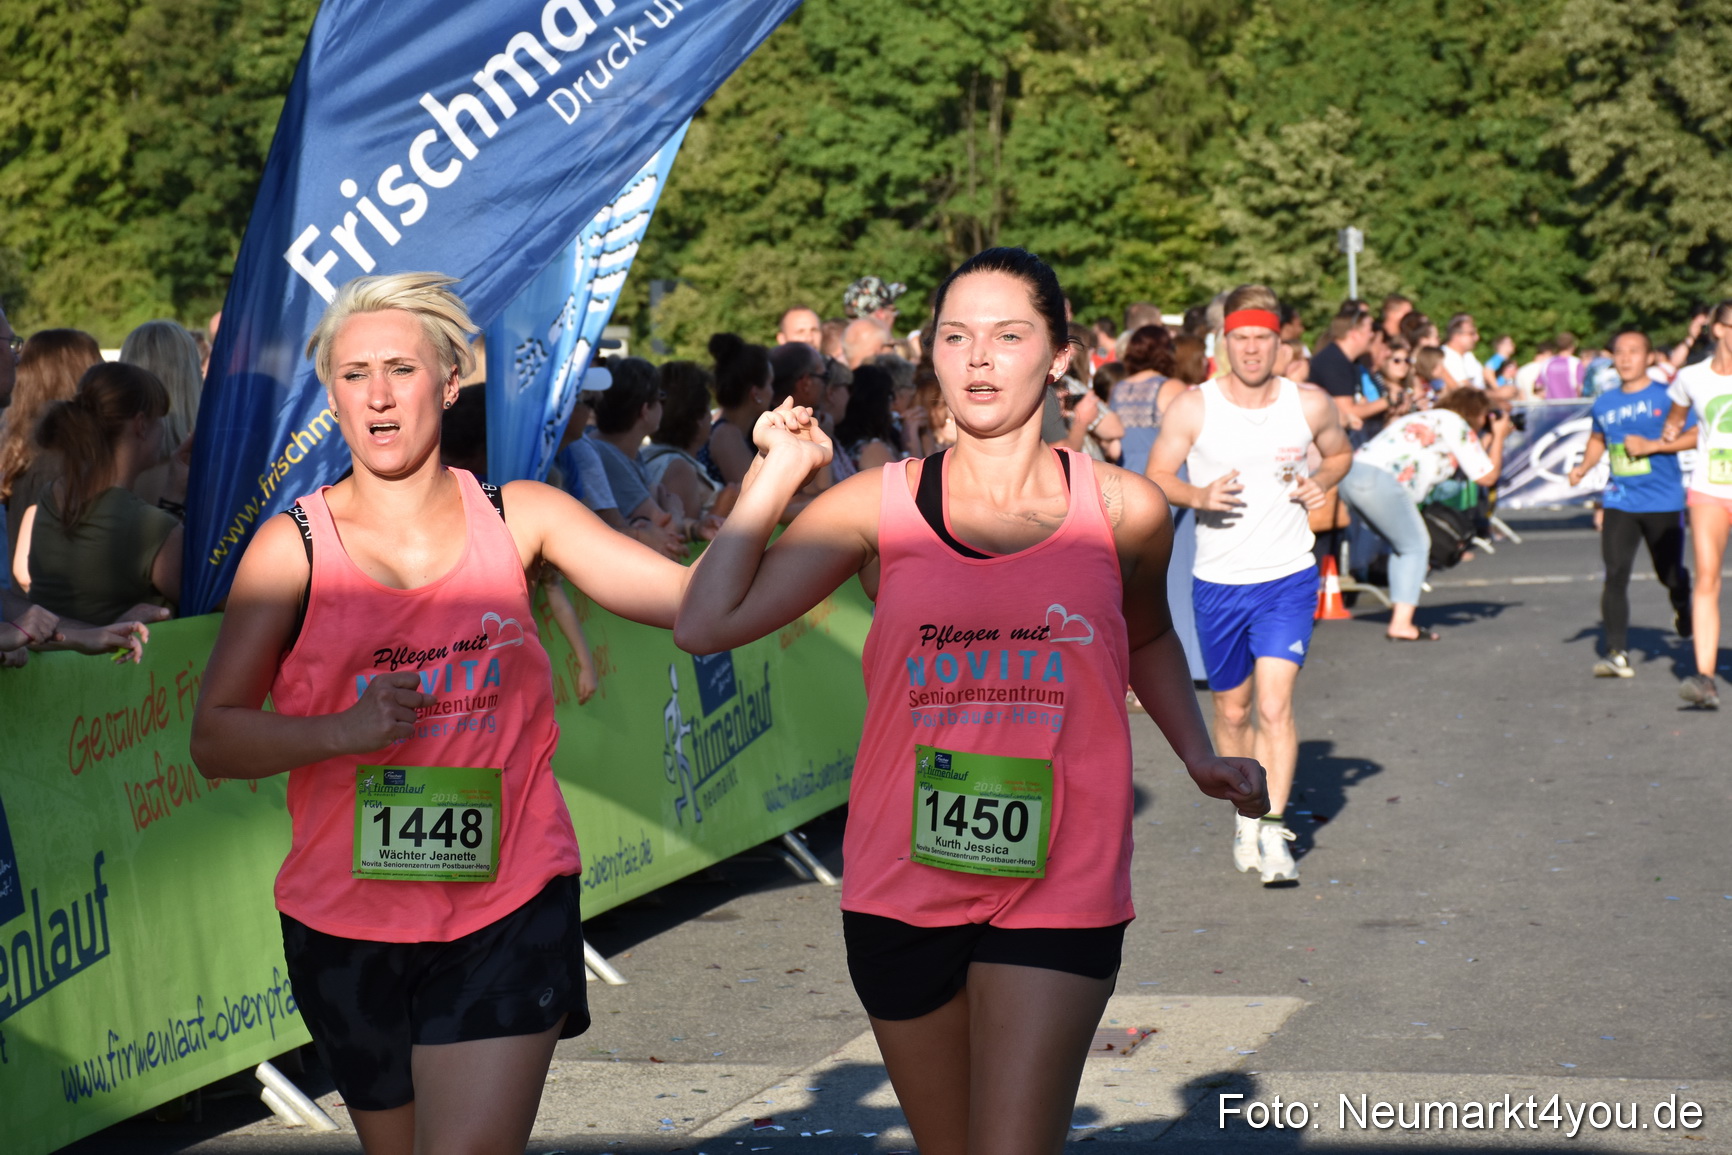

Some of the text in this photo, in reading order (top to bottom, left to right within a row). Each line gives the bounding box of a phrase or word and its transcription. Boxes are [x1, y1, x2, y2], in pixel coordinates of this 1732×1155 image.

[546, 0, 684, 125] Druck u
[283, 0, 617, 305] Frischma
[373, 634, 488, 671] Pflegen mit
[919, 624, 1050, 650] Pflegen mit
[355, 658, 500, 700] NVITA
[905, 649, 1065, 686] NOVITA
[908, 685, 1065, 707] Seniorenzentrum
[68, 670, 170, 775] Gesunde
[691, 661, 772, 788] firmenlauf
[124, 750, 201, 831] laufen
[373, 783, 425, 794] firmenlauf
[927, 765, 970, 781] firmenlauf
[373, 806, 483, 849] 1448
[926, 790, 1029, 843] 1450
[379, 849, 477, 861] Wächter Jeanette
[916, 843, 931, 853] Novita
[931, 846, 980, 861] Seniorenzentrum
[981, 855, 1036, 867] Postbauer-Heng
[935, 836, 1009, 855] Kurth Jessica
[383, 861, 440, 869] Seniorenzentrum
[442, 862, 490, 871] Postbauer-Heng
